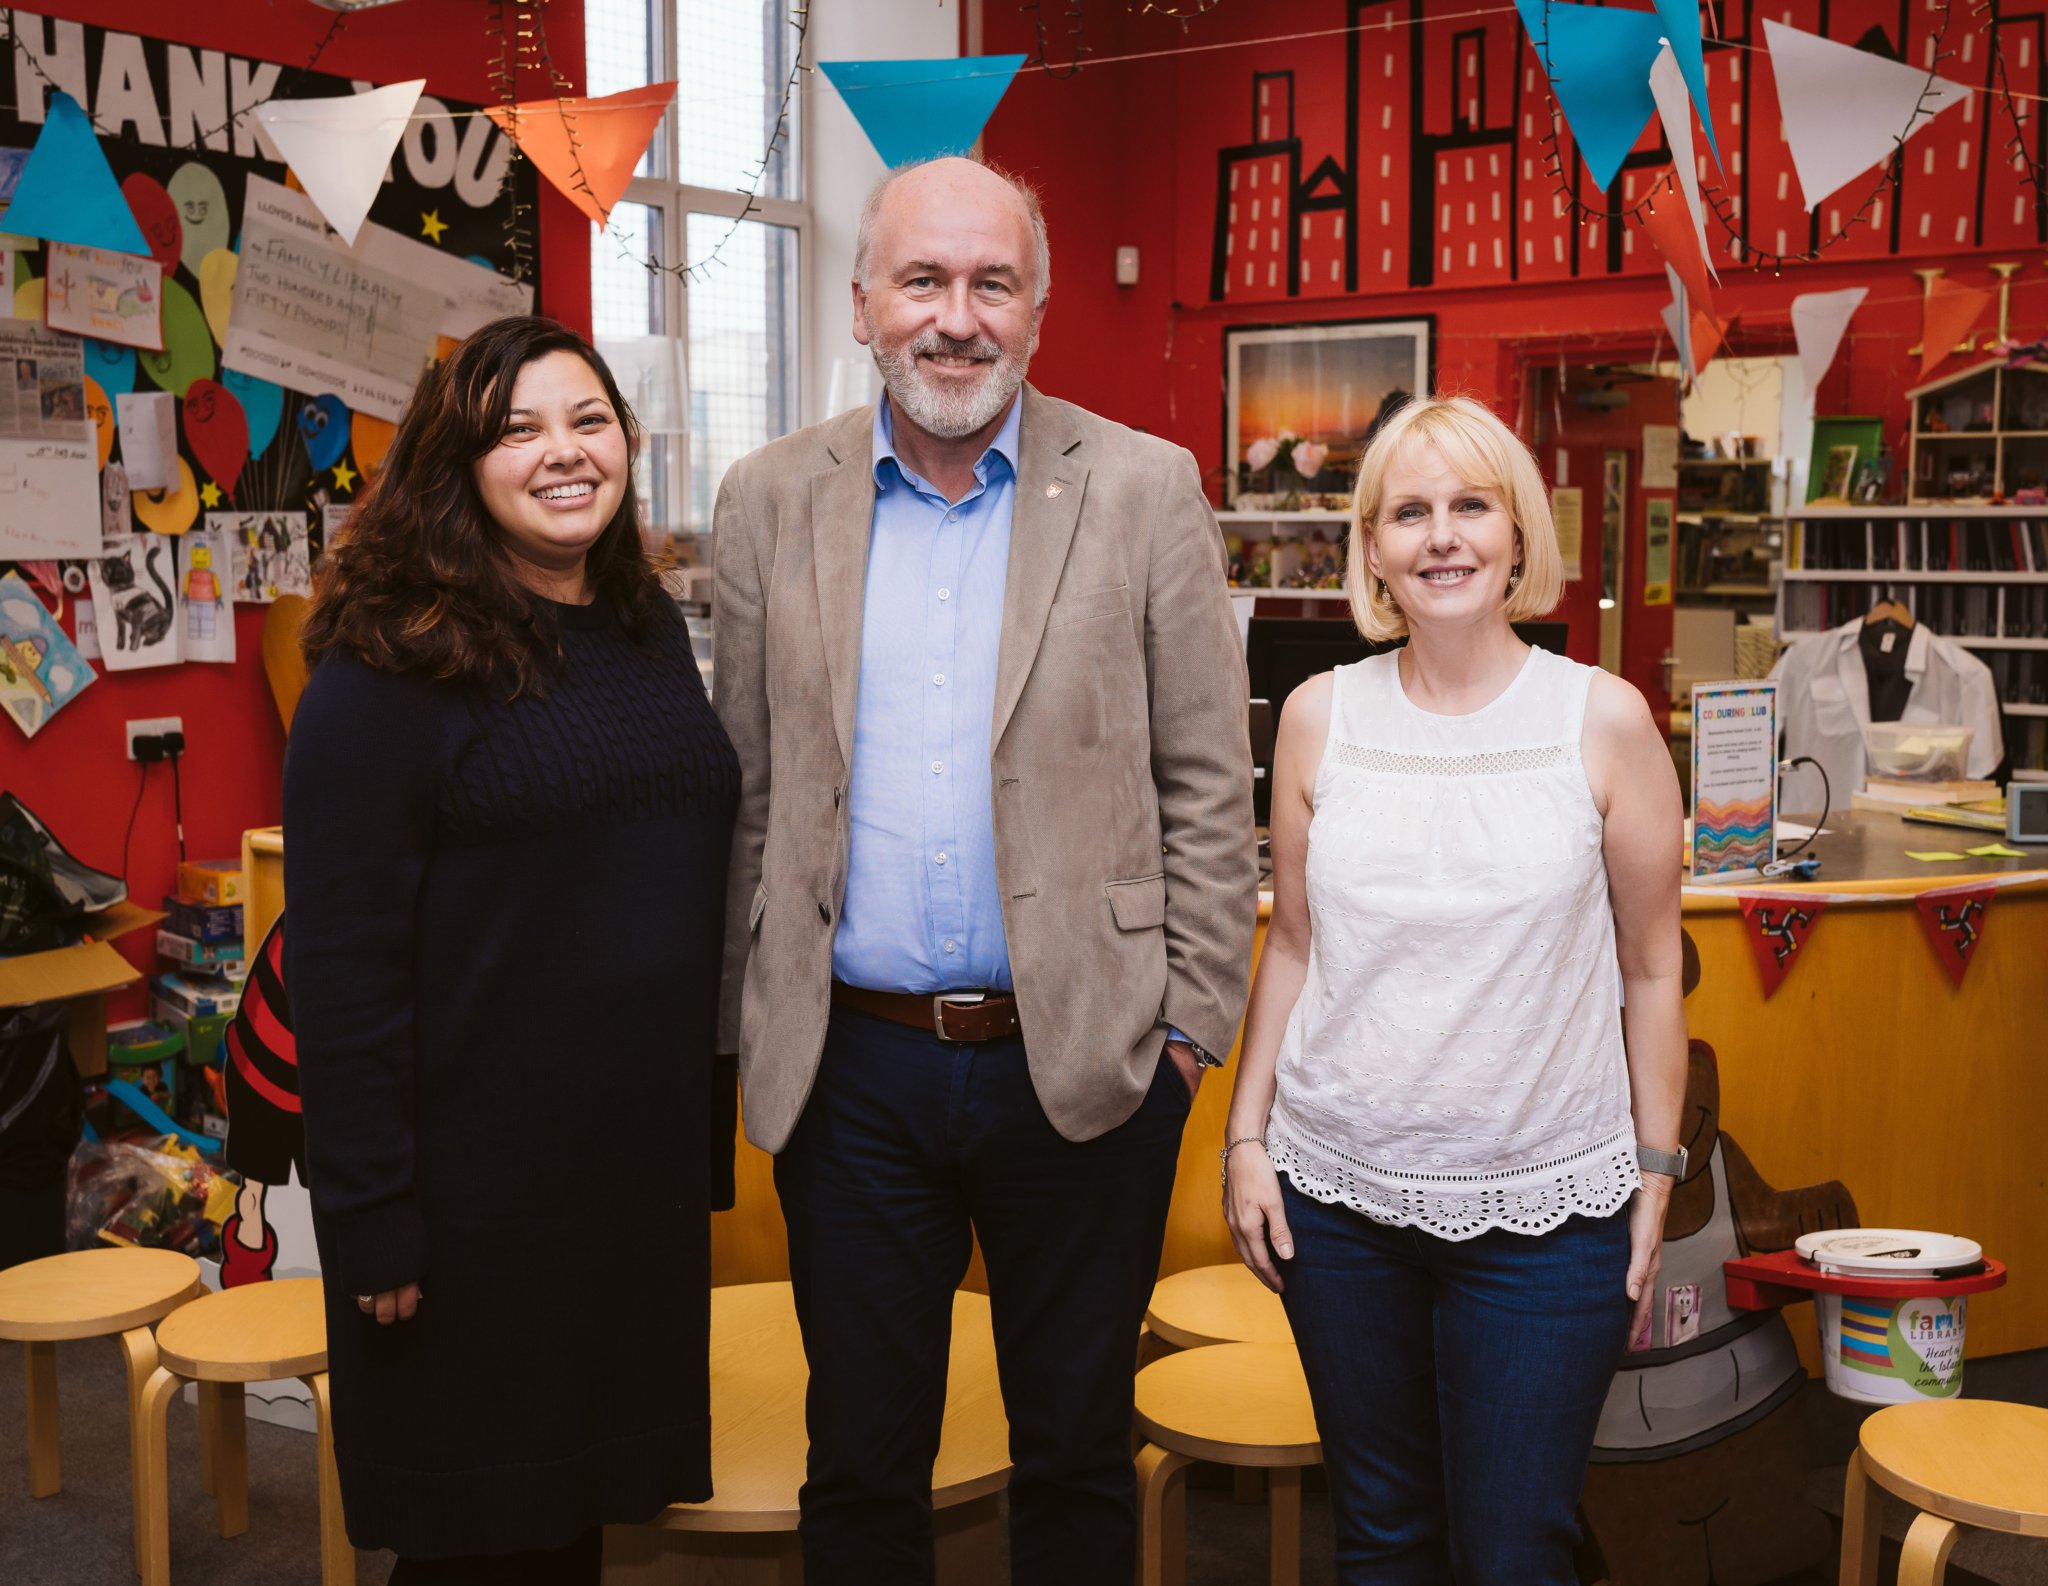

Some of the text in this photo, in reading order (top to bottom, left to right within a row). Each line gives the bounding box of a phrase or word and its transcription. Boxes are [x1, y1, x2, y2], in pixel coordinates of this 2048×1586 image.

[0, 7, 511, 208] HANK OU
[257, 200, 322, 232] LLOYDS BANK
[266, 238, 403, 311] FAMILY LIBRARY
[244, 288, 290, 317] FIFTY
[1919, 1360, 1936, 1373] the
[1925, 1345, 1953, 1360] Heart
